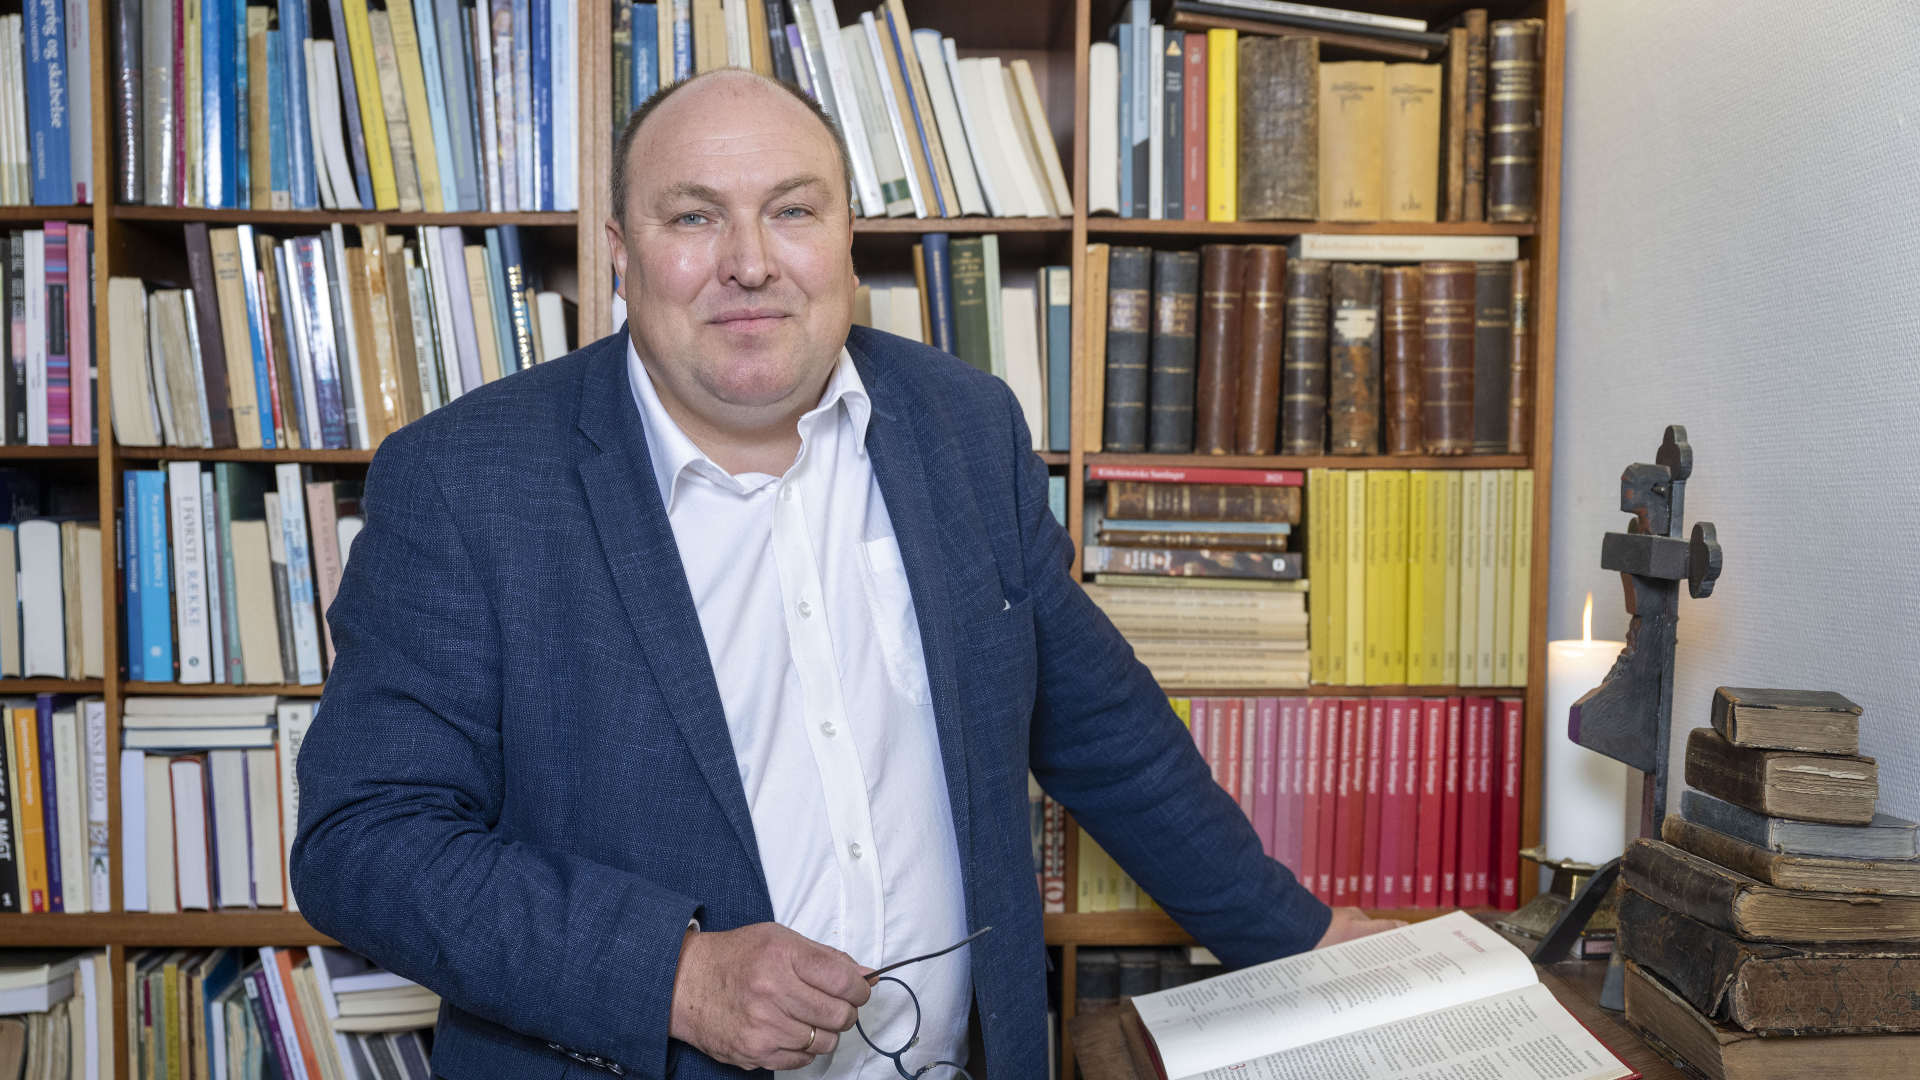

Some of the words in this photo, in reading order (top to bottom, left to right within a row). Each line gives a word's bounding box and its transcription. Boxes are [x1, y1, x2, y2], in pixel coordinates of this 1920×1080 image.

[43, 39, 58, 60] og
[48, 62, 65, 128] skabelse
[1310, 241, 1375, 252] Kirkehistoriske
[1379, 242, 1424, 253] Samlinger
[1098, 469, 1149, 479] Kirkehistoriske
[1150, 470, 1185, 480] Samlinger
[181, 506, 199, 566] FØRSTE
[129, 558, 137, 593] teologi
[154, 552, 162, 580] BØRN
[184, 570, 203, 628] RÆKKE
[91, 710, 105, 756] ESSEN
[24, 770, 33, 805] Theologie
